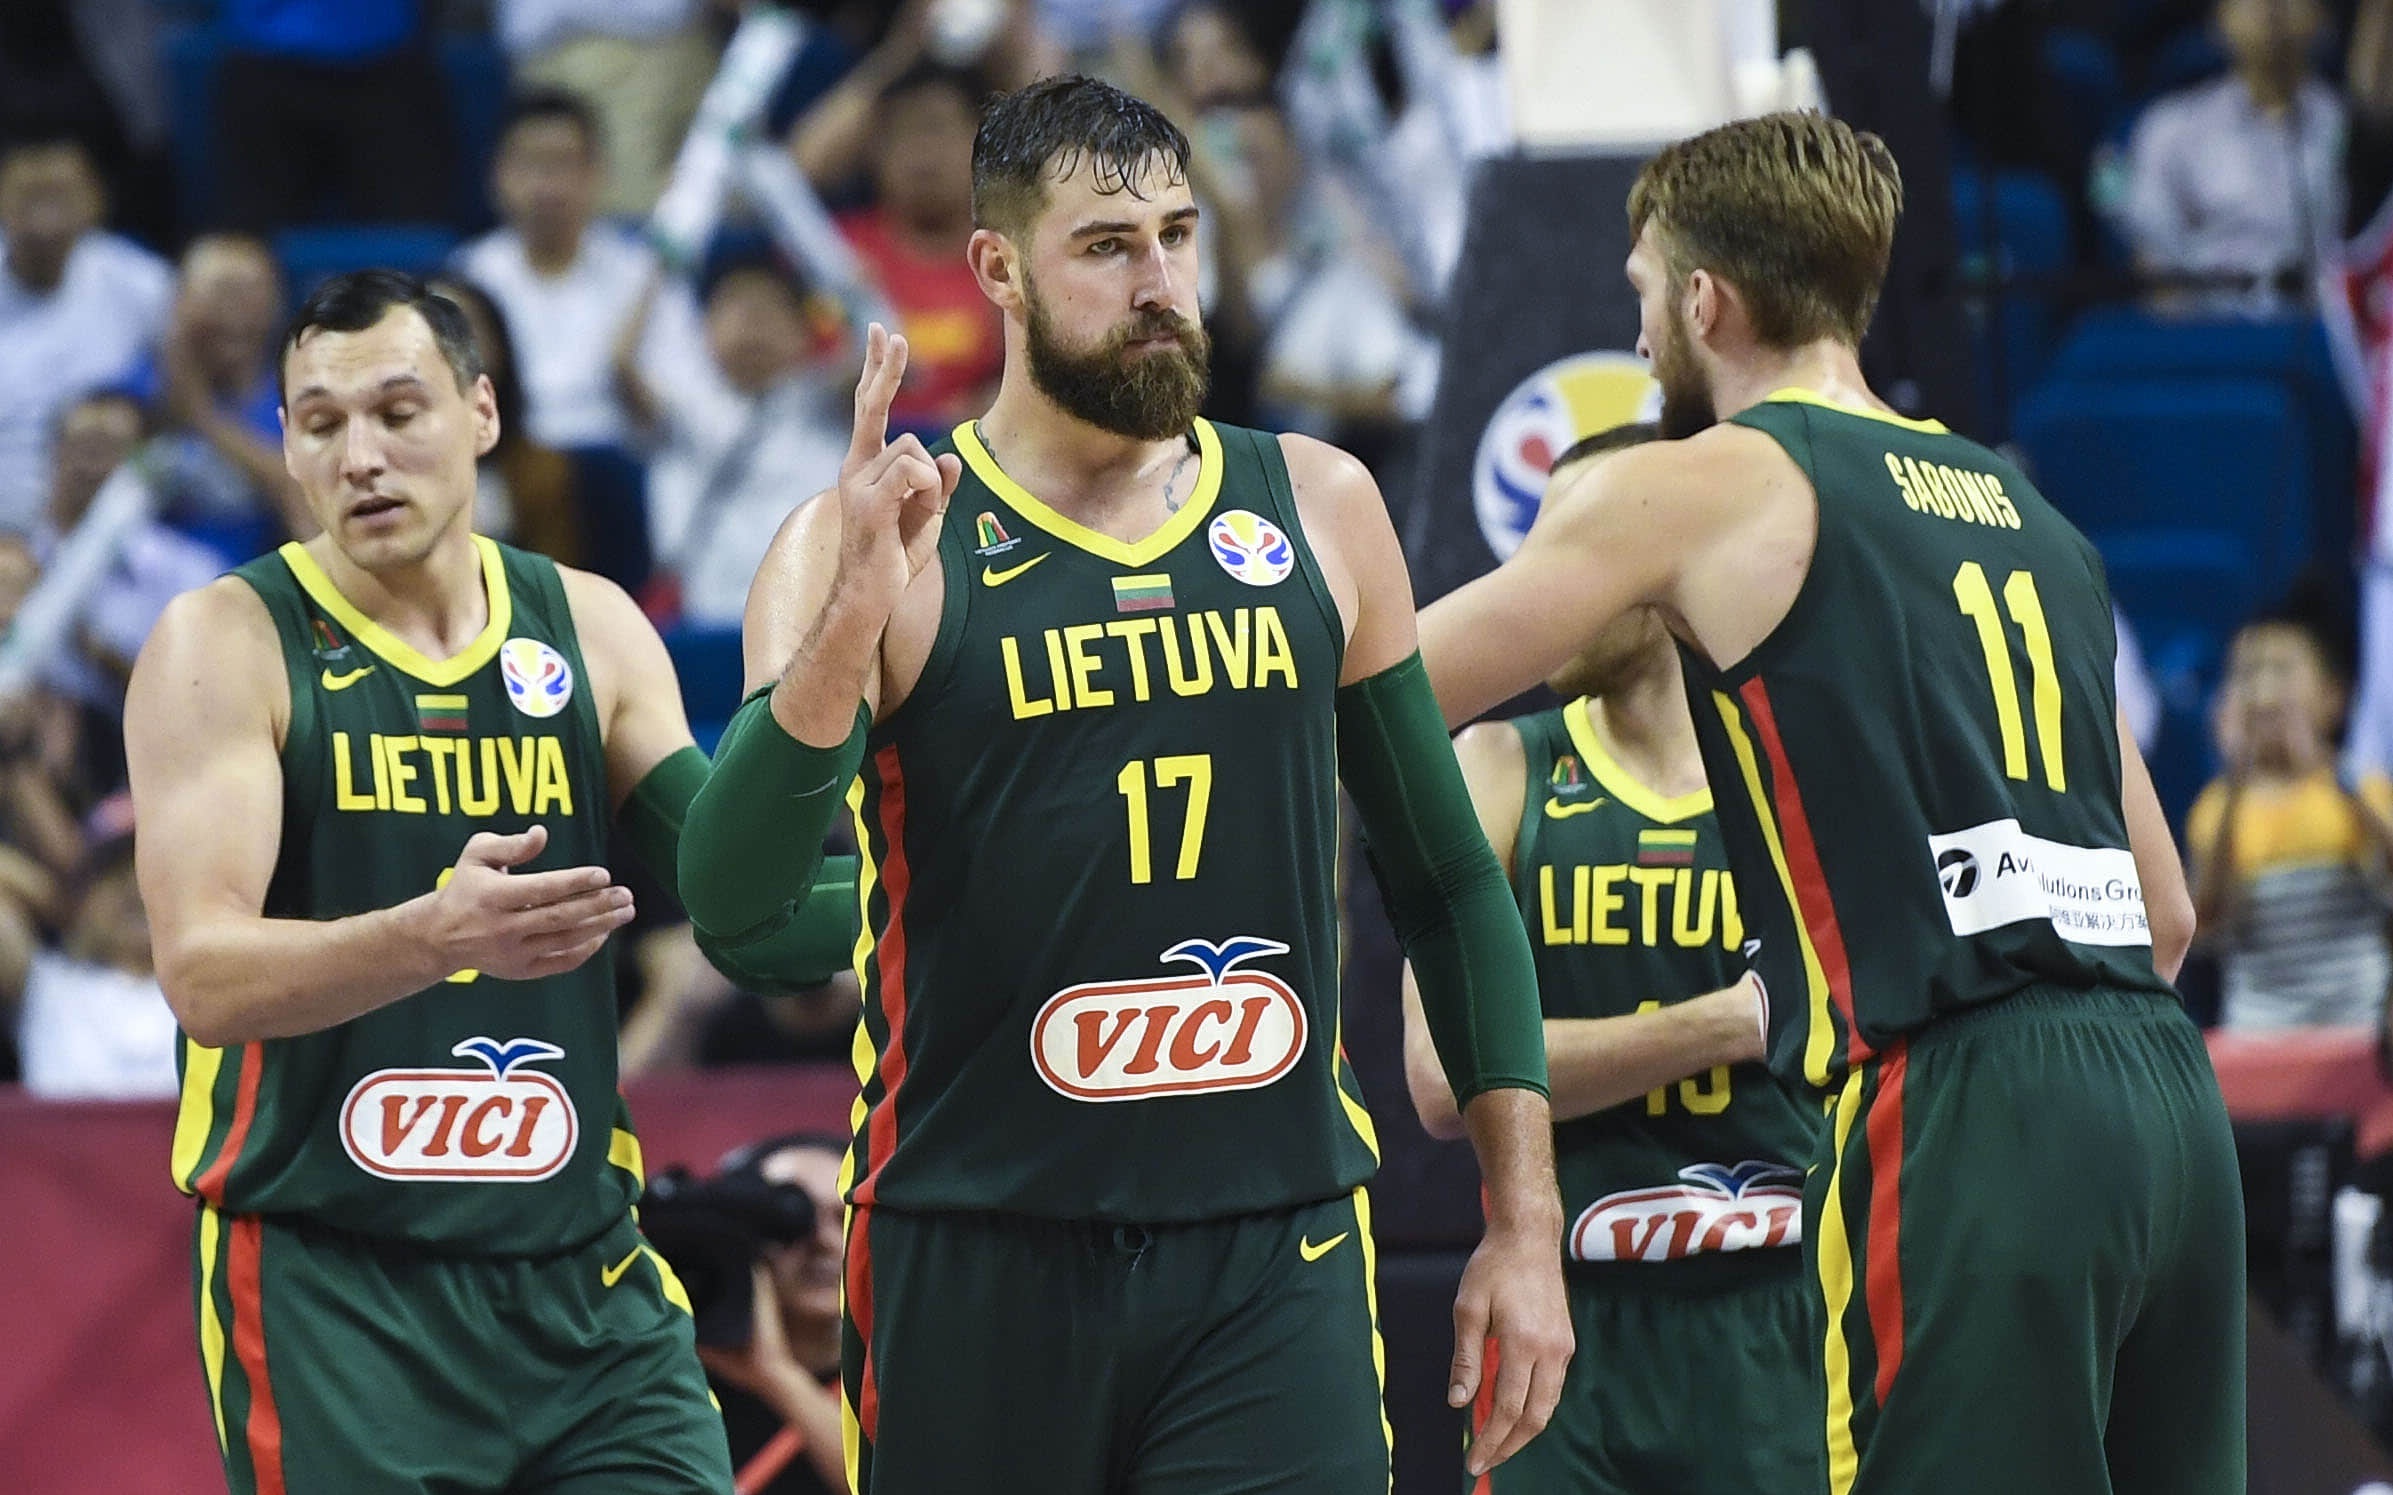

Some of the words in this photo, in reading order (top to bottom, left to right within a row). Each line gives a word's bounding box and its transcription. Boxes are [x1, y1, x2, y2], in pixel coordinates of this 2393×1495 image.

[1884, 451, 2022, 530] SABONIS
[1001, 606, 1298, 720] LIETUVA
[1952, 560, 2066, 793] 11
[332, 731, 574, 816] LIETUVA
[1117, 753, 1212, 884] 17
[1539, 864, 1744, 952] LIETUV
[2039, 872, 2102, 901] lutions
[1073, 997, 1272, 1079] VICI
[381, 1095, 549, 1158] VICI
